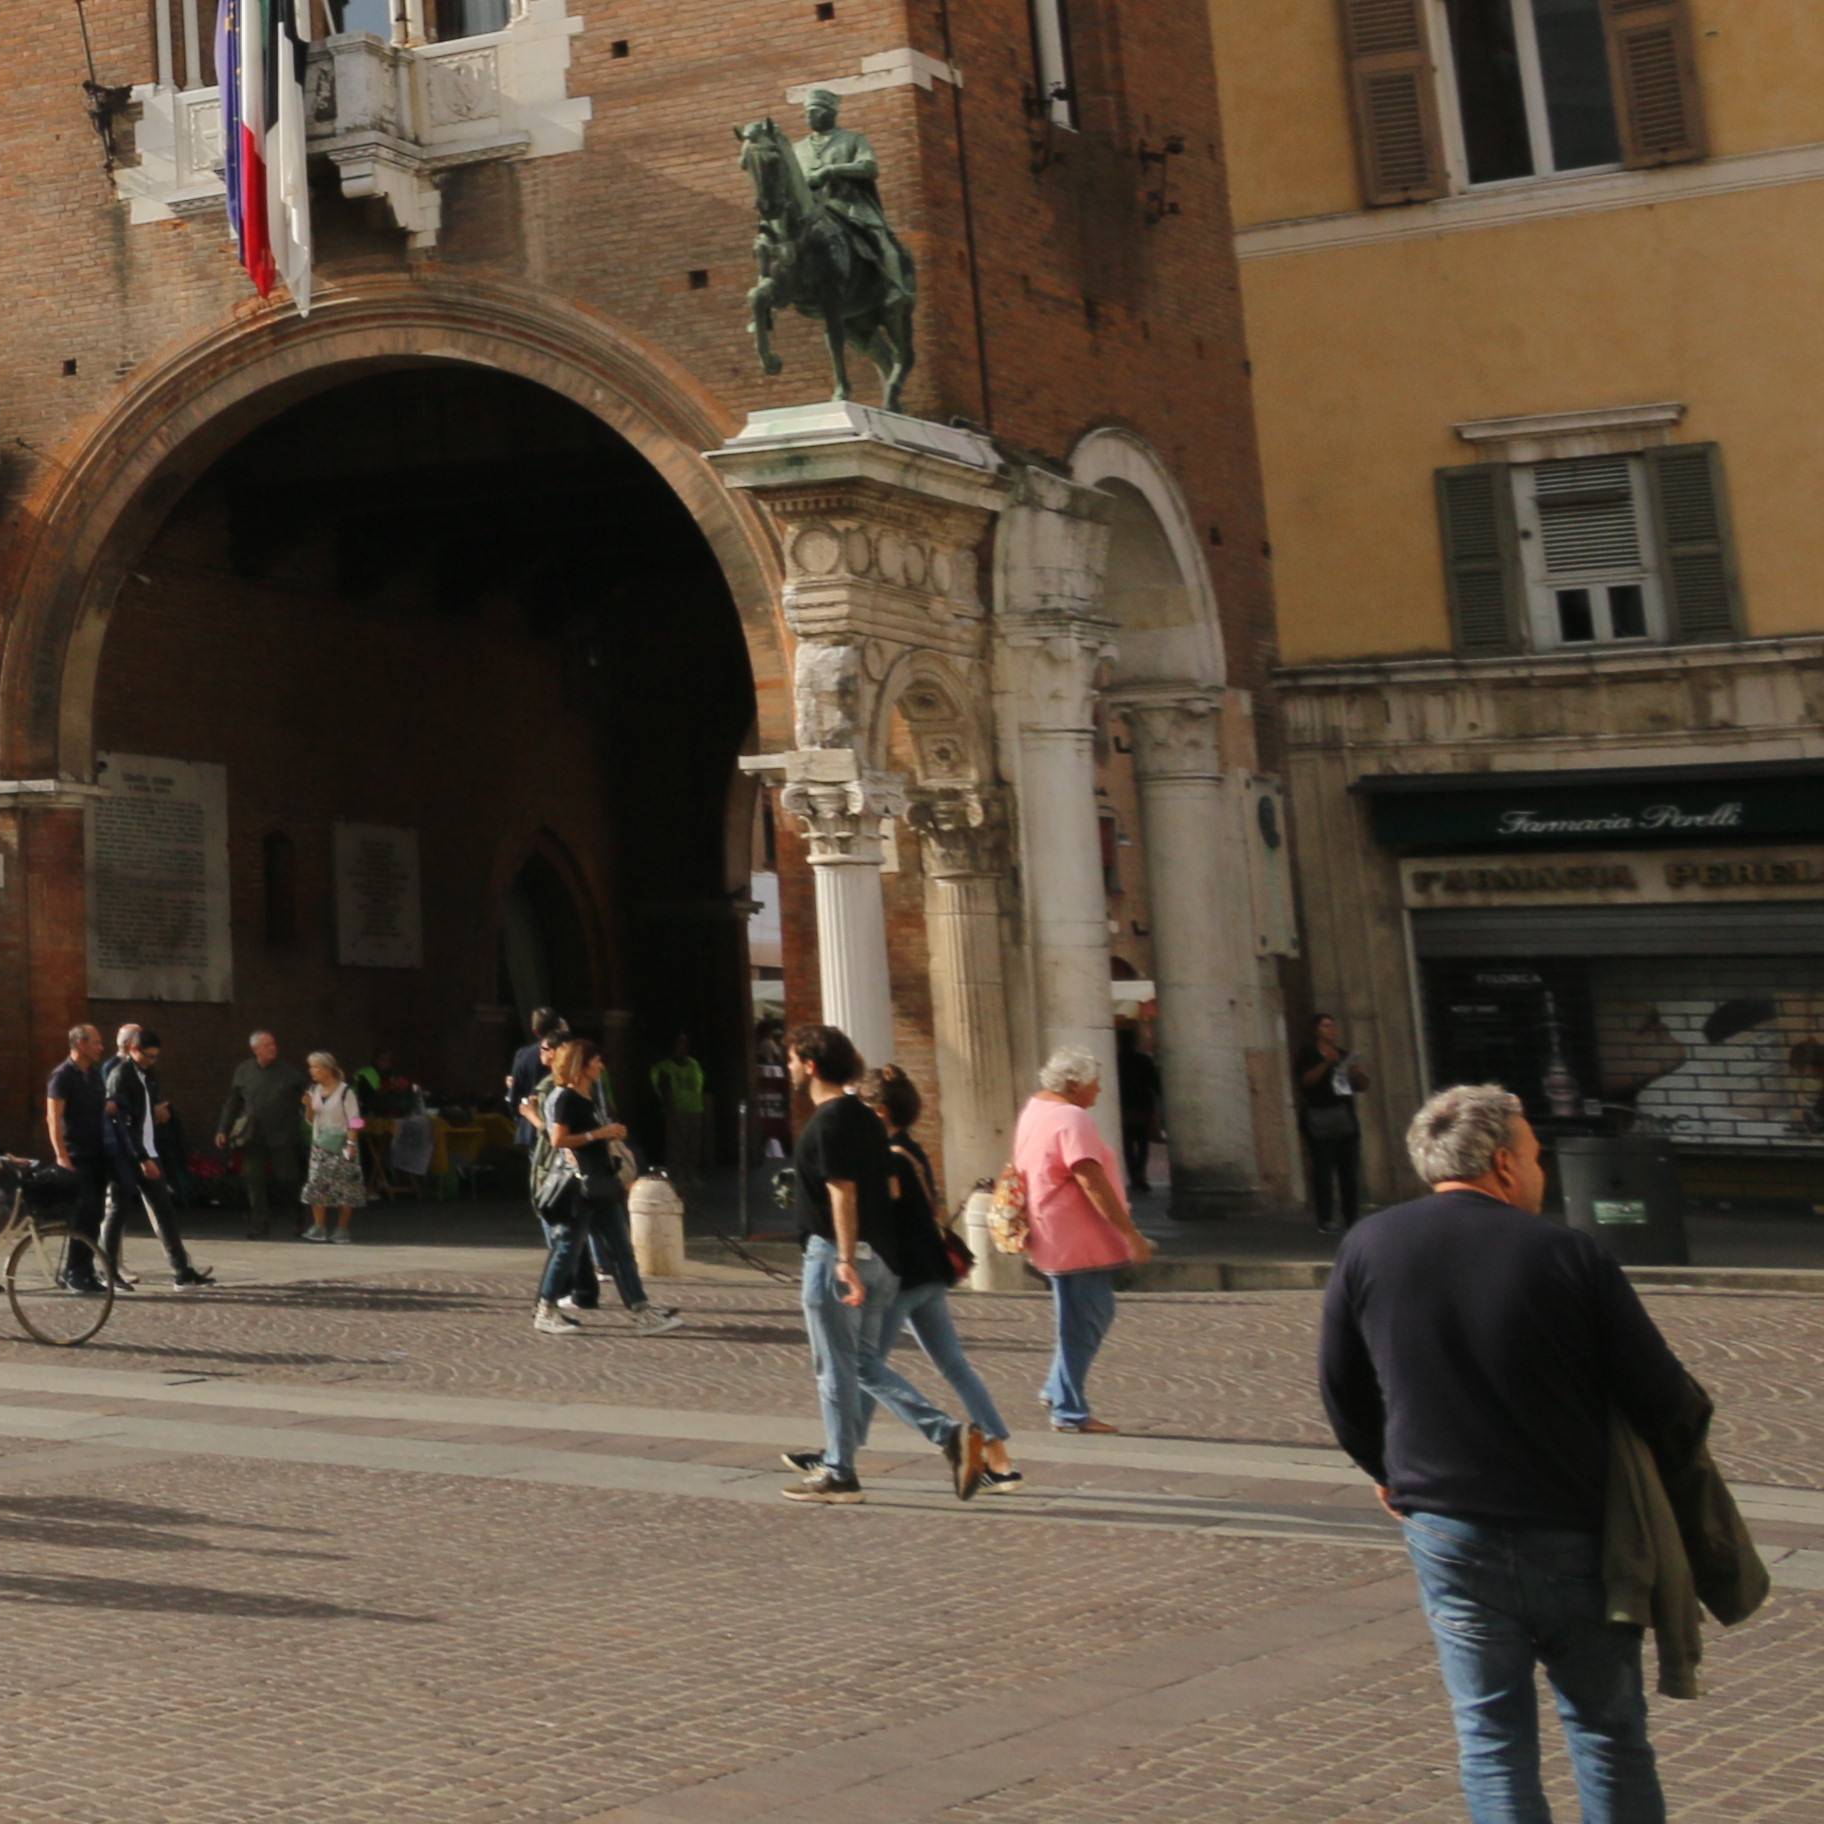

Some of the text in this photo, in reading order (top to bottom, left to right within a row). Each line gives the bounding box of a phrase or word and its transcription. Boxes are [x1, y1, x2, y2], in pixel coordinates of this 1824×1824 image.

[1498, 802, 1743, 834] Farmacia Perelli
[1662, 859, 1824, 890] PEREL
